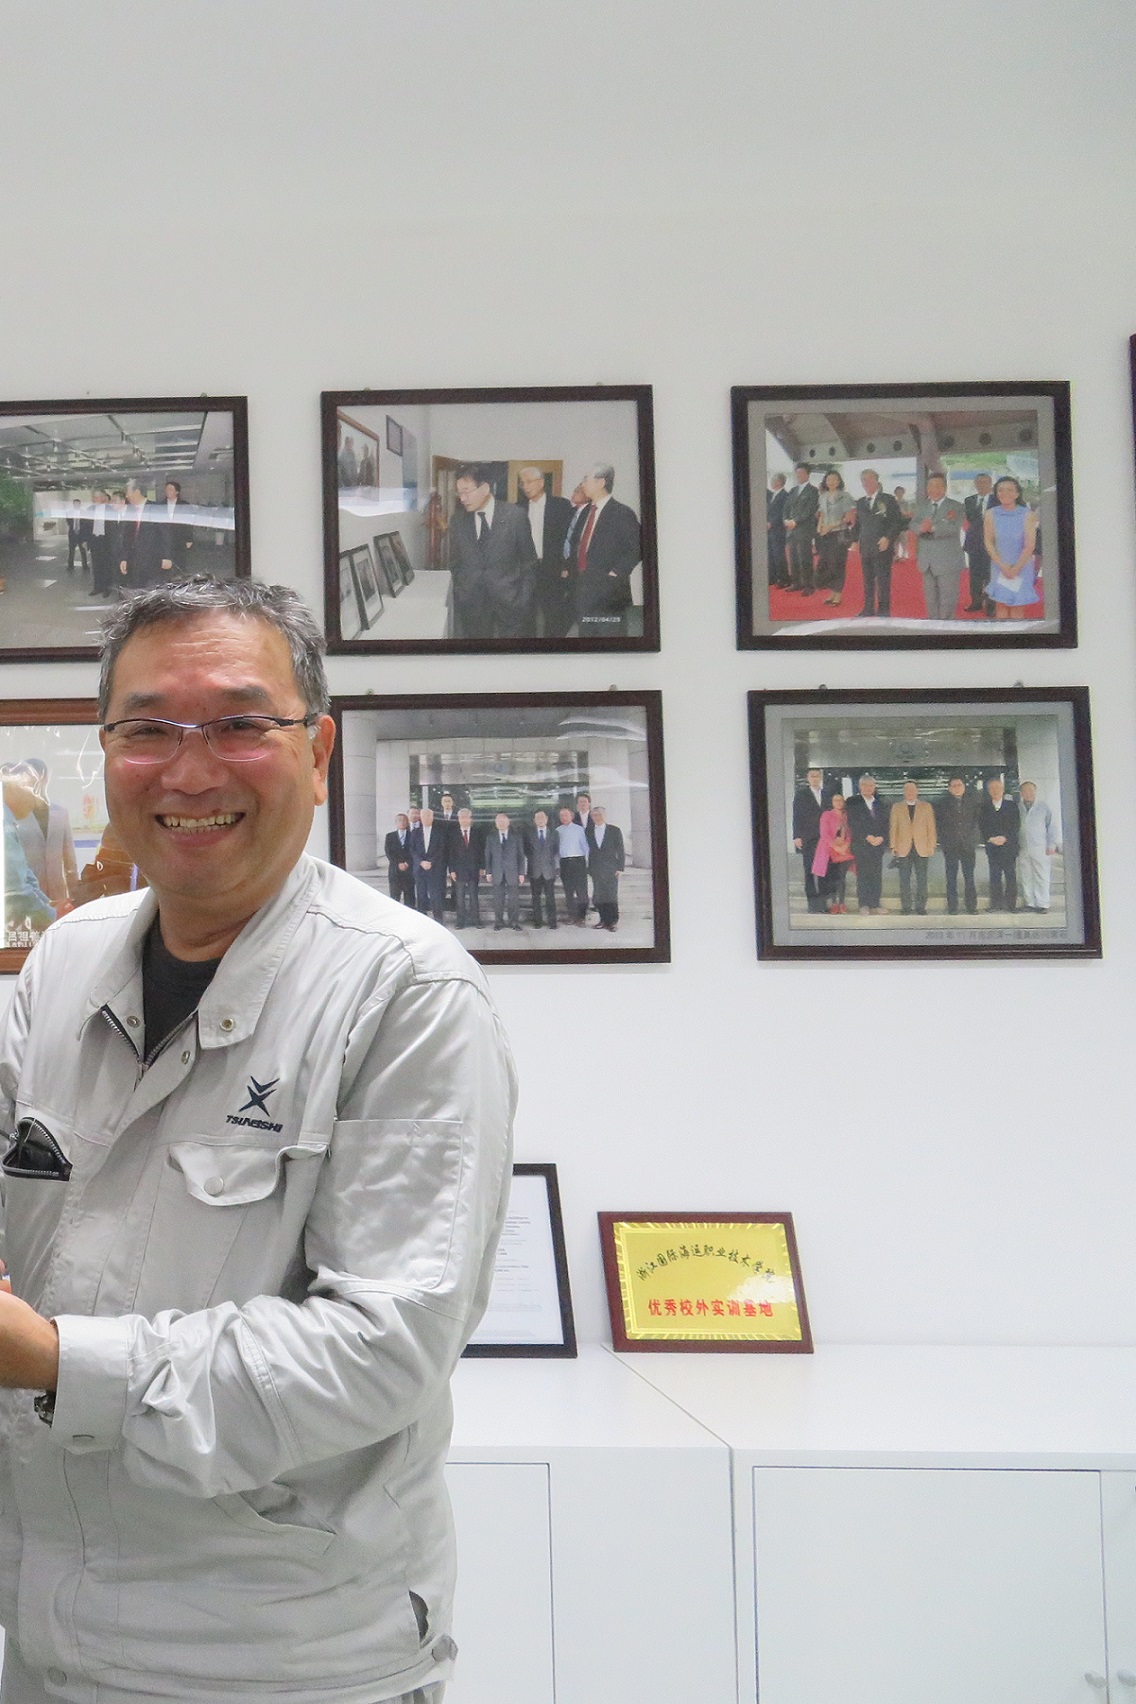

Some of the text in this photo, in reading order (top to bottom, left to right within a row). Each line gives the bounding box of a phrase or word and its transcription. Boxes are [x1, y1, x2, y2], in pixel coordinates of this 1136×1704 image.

[225, 1115, 284, 1133] TSUNEISHI
[648, 1298, 774, 1317] 优秀校外实训基地
